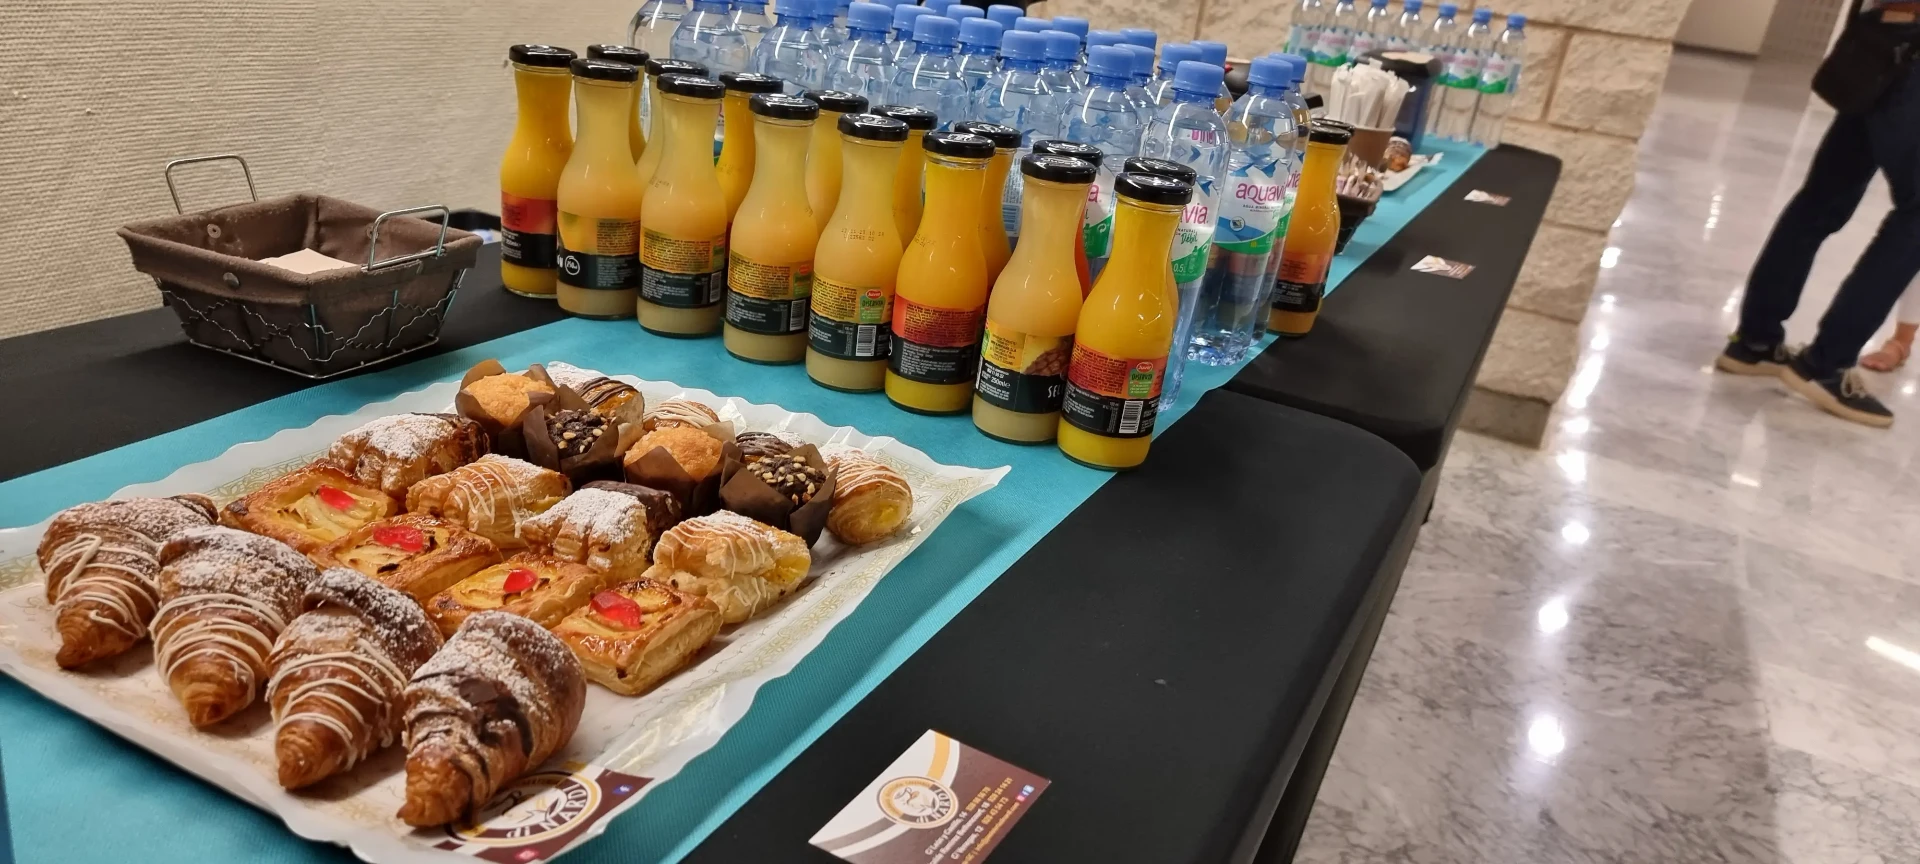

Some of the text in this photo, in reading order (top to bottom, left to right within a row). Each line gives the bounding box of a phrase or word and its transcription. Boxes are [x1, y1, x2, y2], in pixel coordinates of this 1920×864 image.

[1236, 182, 1286, 205] aquavi
[1181, 203, 1207, 224] via
[506, 783, 587, 838] di NARDI
